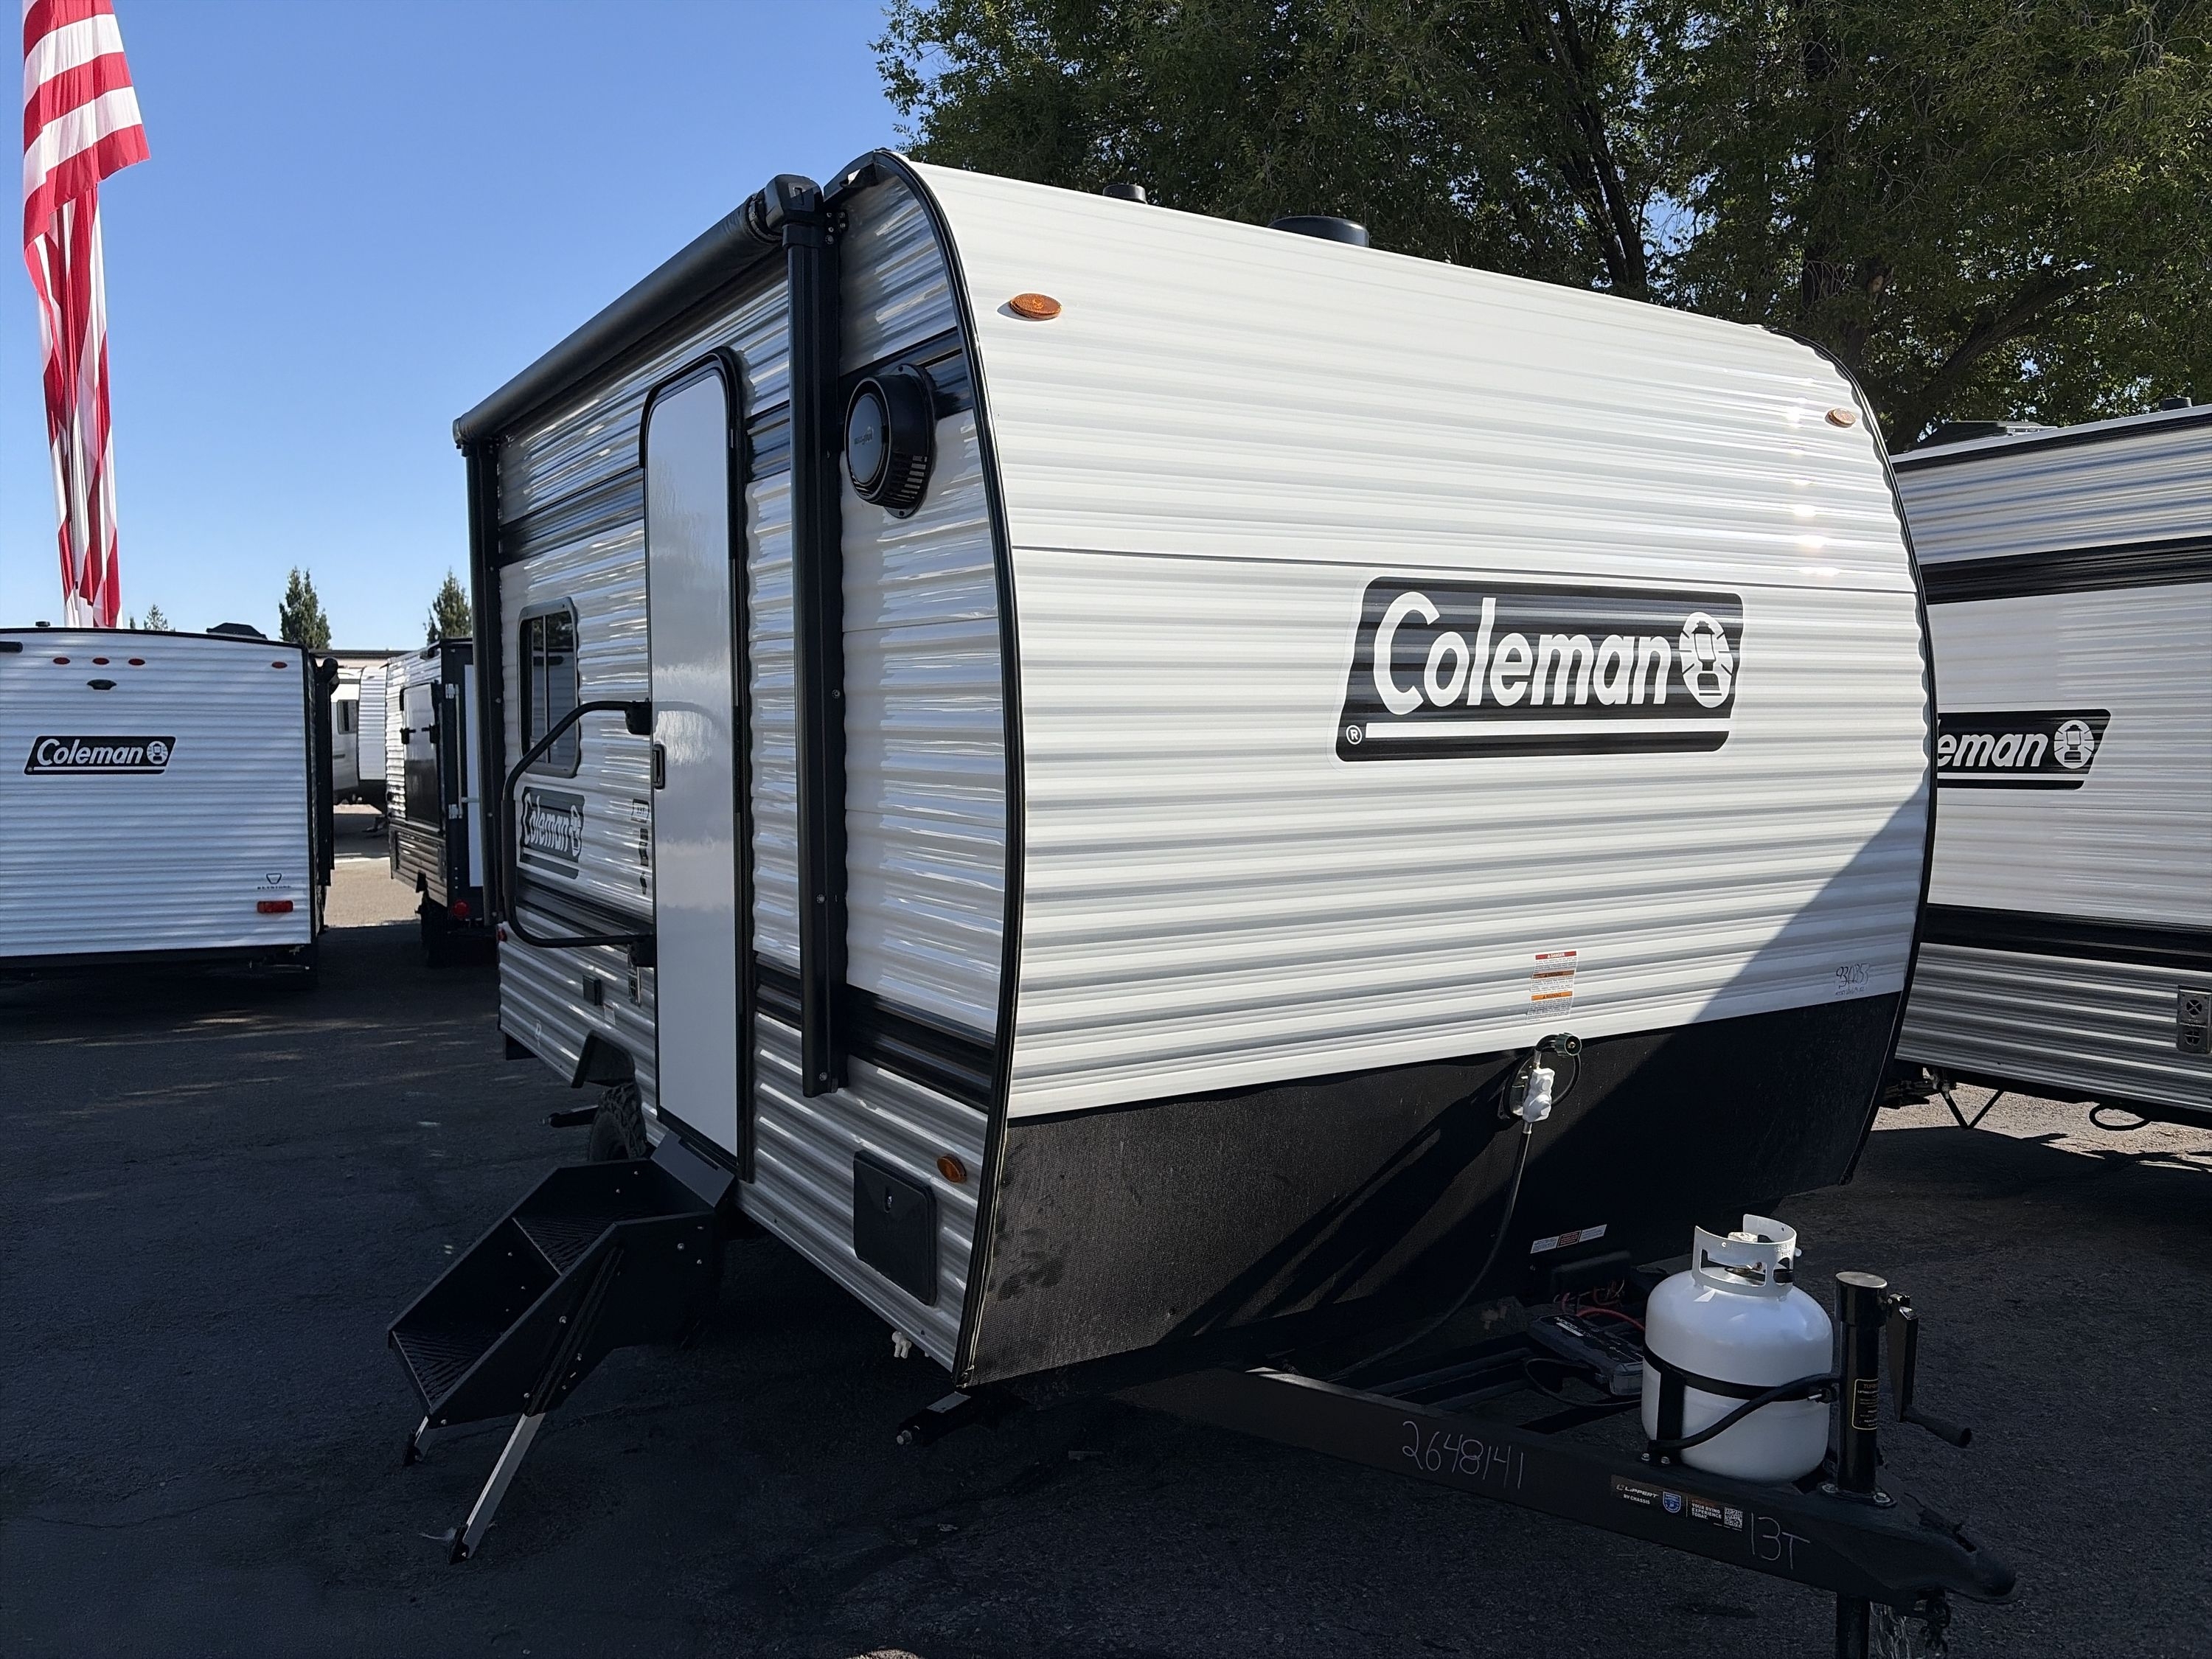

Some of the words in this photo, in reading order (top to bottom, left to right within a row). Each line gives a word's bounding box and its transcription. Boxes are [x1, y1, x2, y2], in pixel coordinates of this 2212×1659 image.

[1374, 591, 1672, 715] Coleman
[37, 738, 144, 766] Coleman
[1938, 720, 2048, 768] eman
[524, 793, 570, 852] Coleman
[1402, 1420, 1524, 1489] 2648141
[1630, 1495, 1651, 1505] CHASSIS
[1691, 1507, 1722, 1519] EXPERIENCE
[1705, 1506, 1720, 1514] RVING
